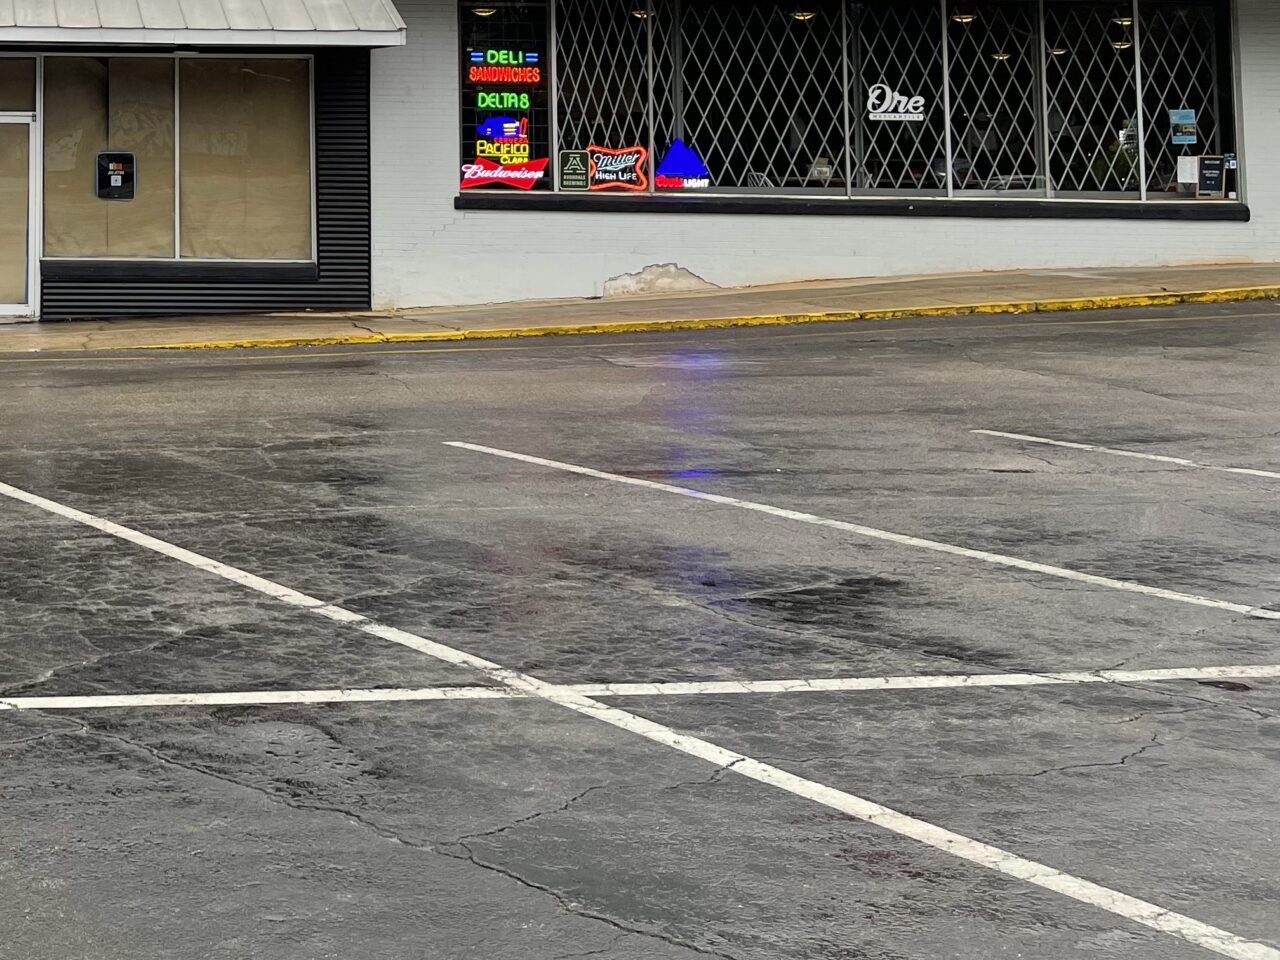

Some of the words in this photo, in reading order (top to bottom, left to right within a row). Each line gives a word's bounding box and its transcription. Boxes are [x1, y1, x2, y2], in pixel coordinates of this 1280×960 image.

[486, 49, 523, 64] DELI
[469, 66, 540, 82] SANDWICHES
[477, 92, 519, 109] DELTA
[519, 93, 530, 109] 8
[866, 83, 925, 113] Ore
[593, 153, 640, 171] Miller
[461, 164, 544, 179] Budweiser
[595, 171, 616, 180] HIGH
[618, 171, 637, 180] LIFE
